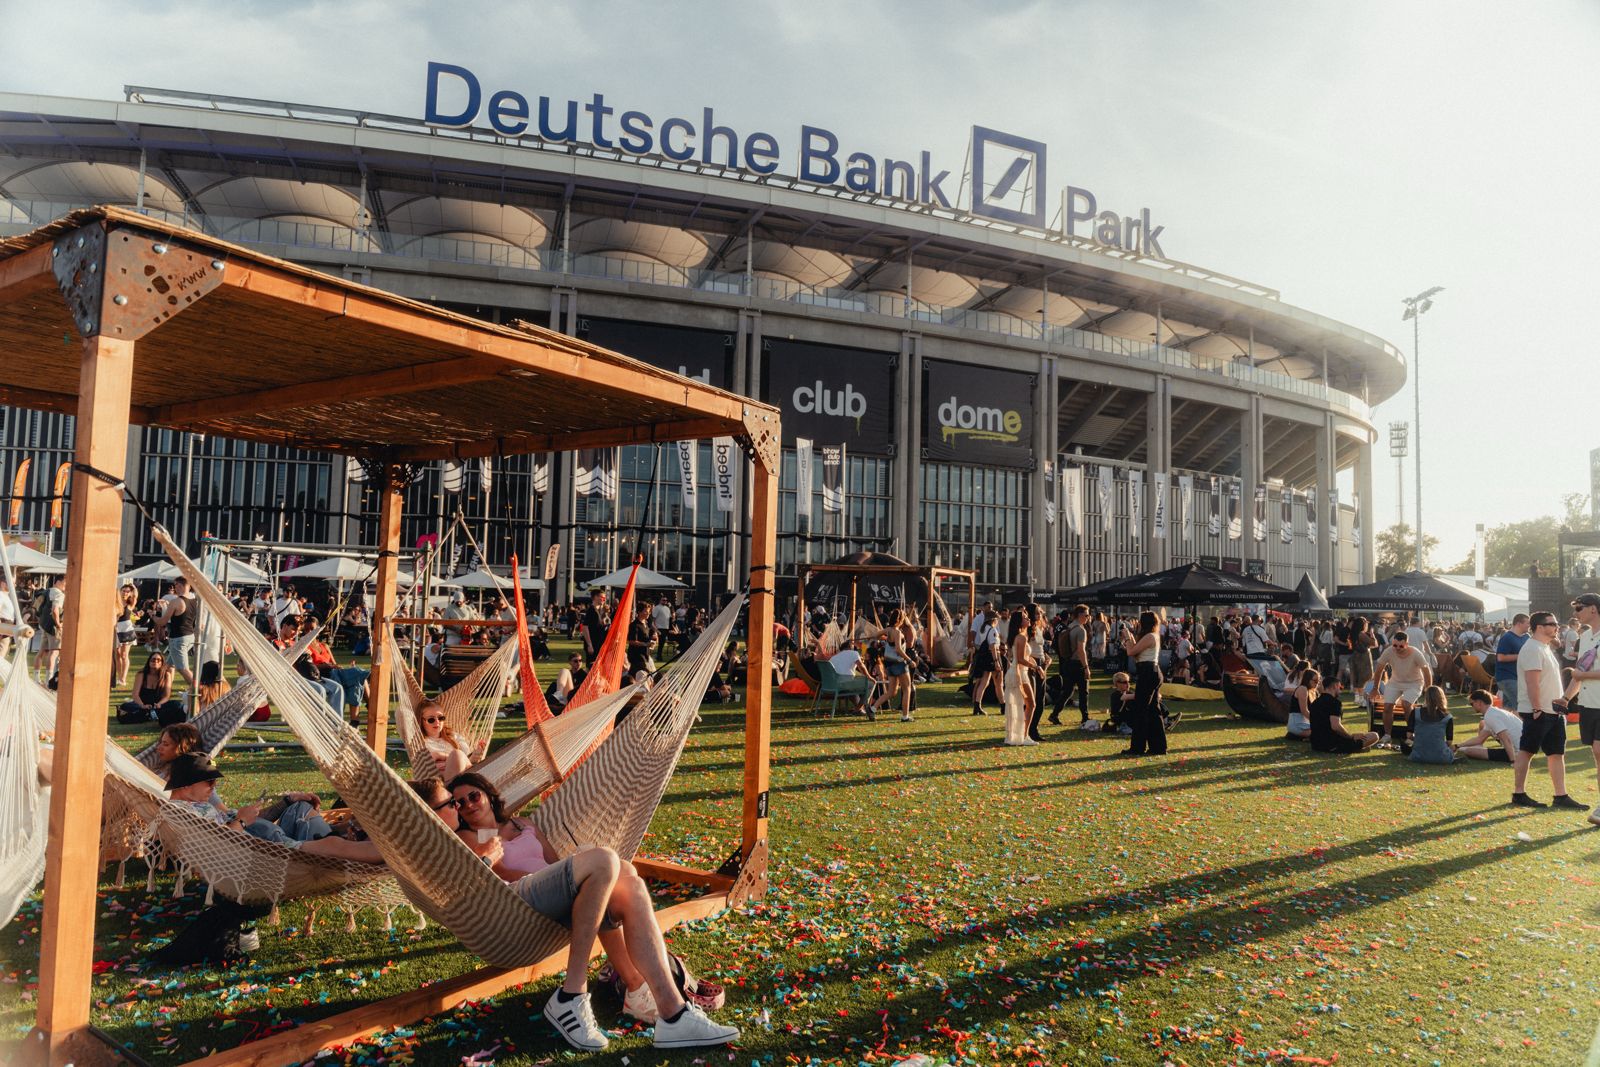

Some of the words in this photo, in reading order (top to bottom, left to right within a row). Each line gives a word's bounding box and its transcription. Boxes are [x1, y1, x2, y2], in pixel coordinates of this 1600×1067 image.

[425, 61, 780, 176] Deutsche
[799, 125, 951, 208] Bank
[1062, 185, 1165, 260] Park
[792, 380, 867, 417] club
[938, 396, 1022, 434] dome
